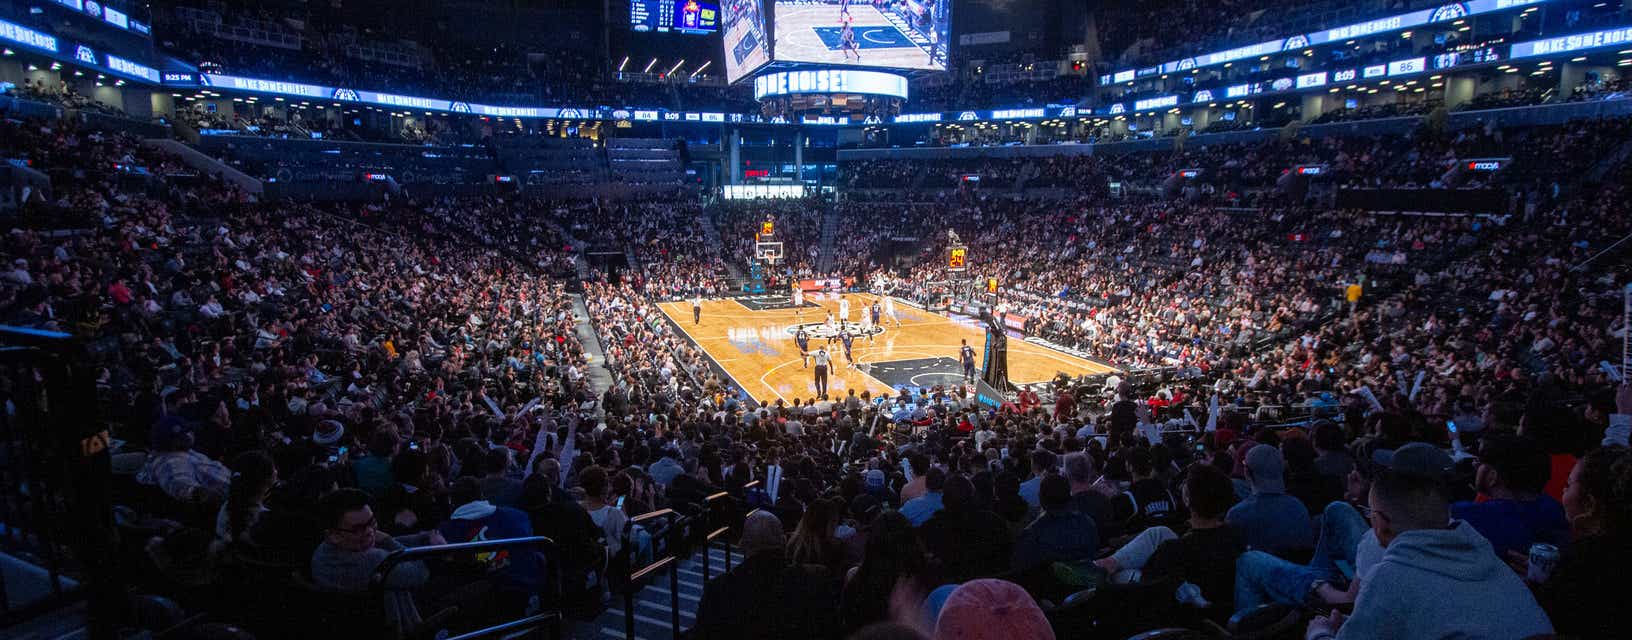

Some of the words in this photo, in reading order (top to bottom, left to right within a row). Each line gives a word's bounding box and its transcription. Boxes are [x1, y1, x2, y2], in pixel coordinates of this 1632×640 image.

[1533, 37, 1566, 55] MAKE
[1567, 31, 1604, 50] SOME
[1604, 28, 1632, 44] NOIS
[788, 70, 848, 92] NOISE!
[1335, 69, 1355, 82] 8:09
[234, 77, 258, 90] MAKE
[258, 79, 283, 93] SOME
[950, 256, 964, 267] 24
